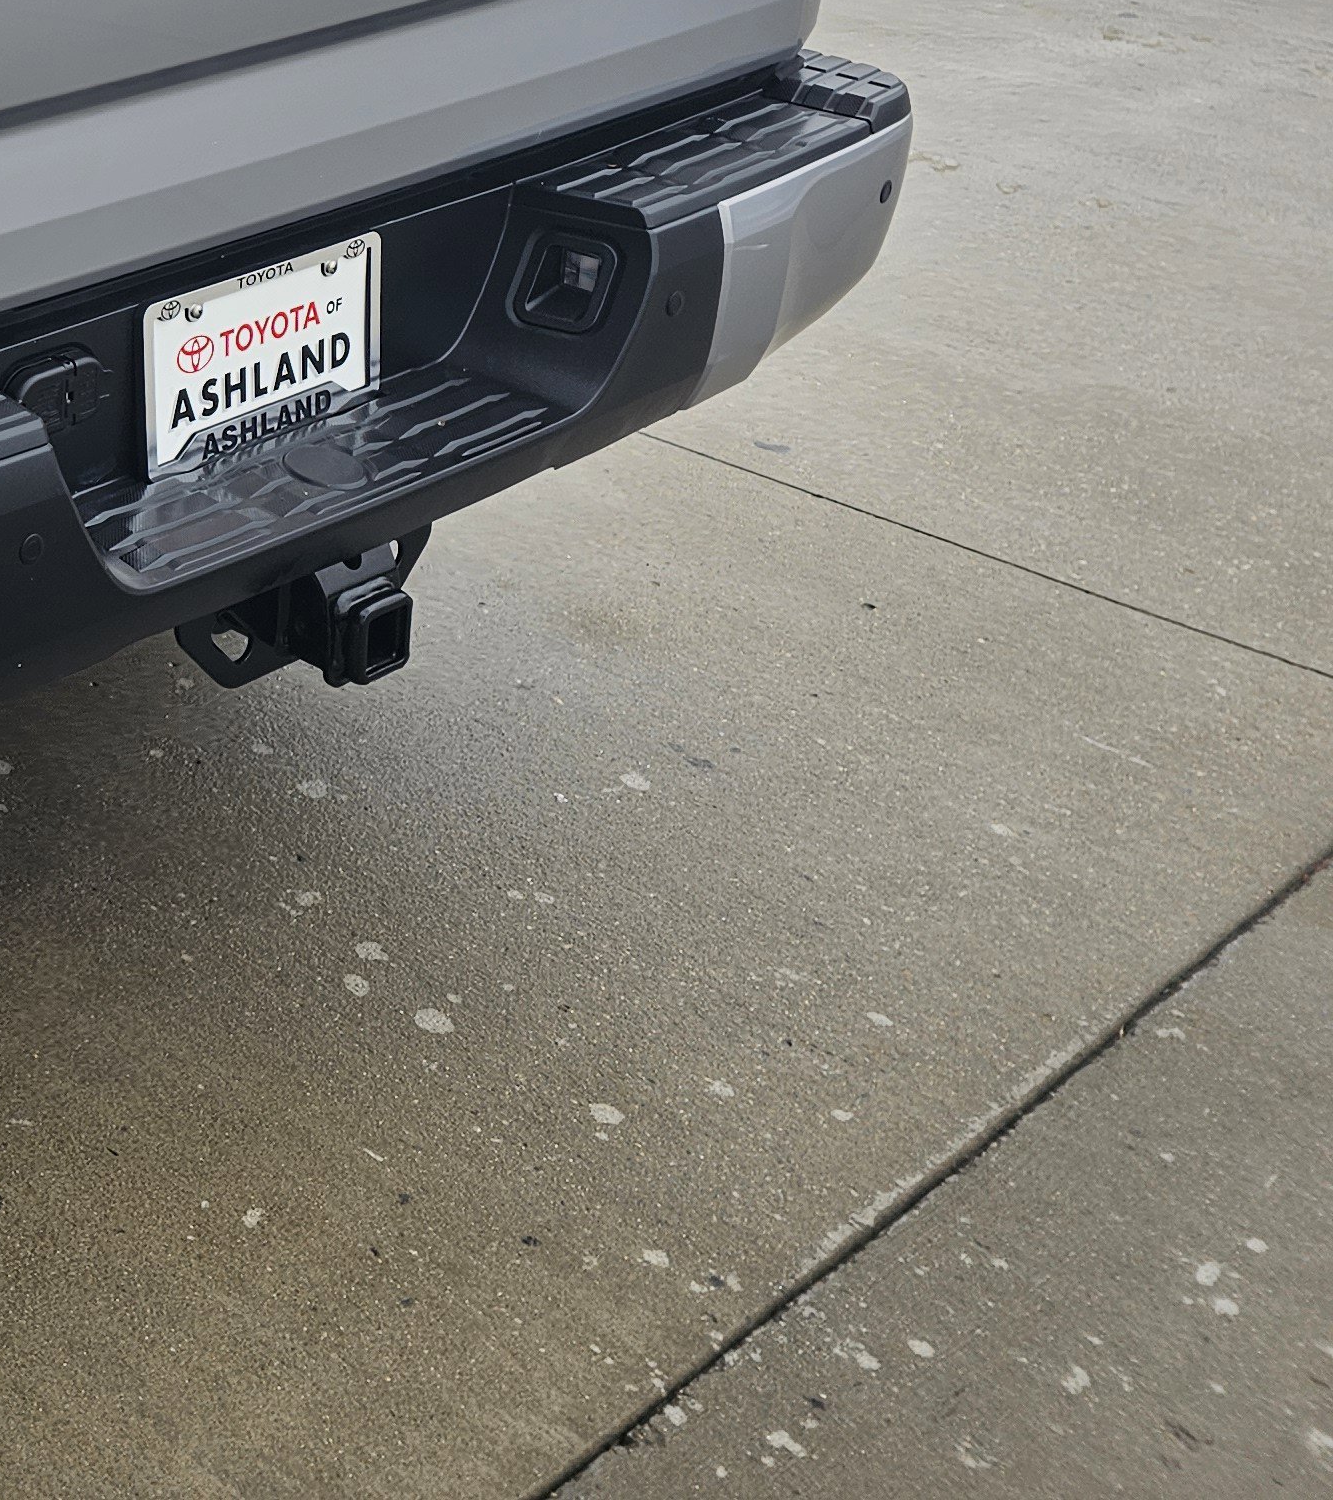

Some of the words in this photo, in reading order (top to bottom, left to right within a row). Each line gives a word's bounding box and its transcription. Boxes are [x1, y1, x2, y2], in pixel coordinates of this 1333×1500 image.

[237, 261, 294, 289] TOYOTA
[220, 301, 321, 357] TOYOTA
[326, 297, 343, 315] OF
[169, 331, 351, 430] ASHLAND
[202, 388, 333, 460] ASHLAND
